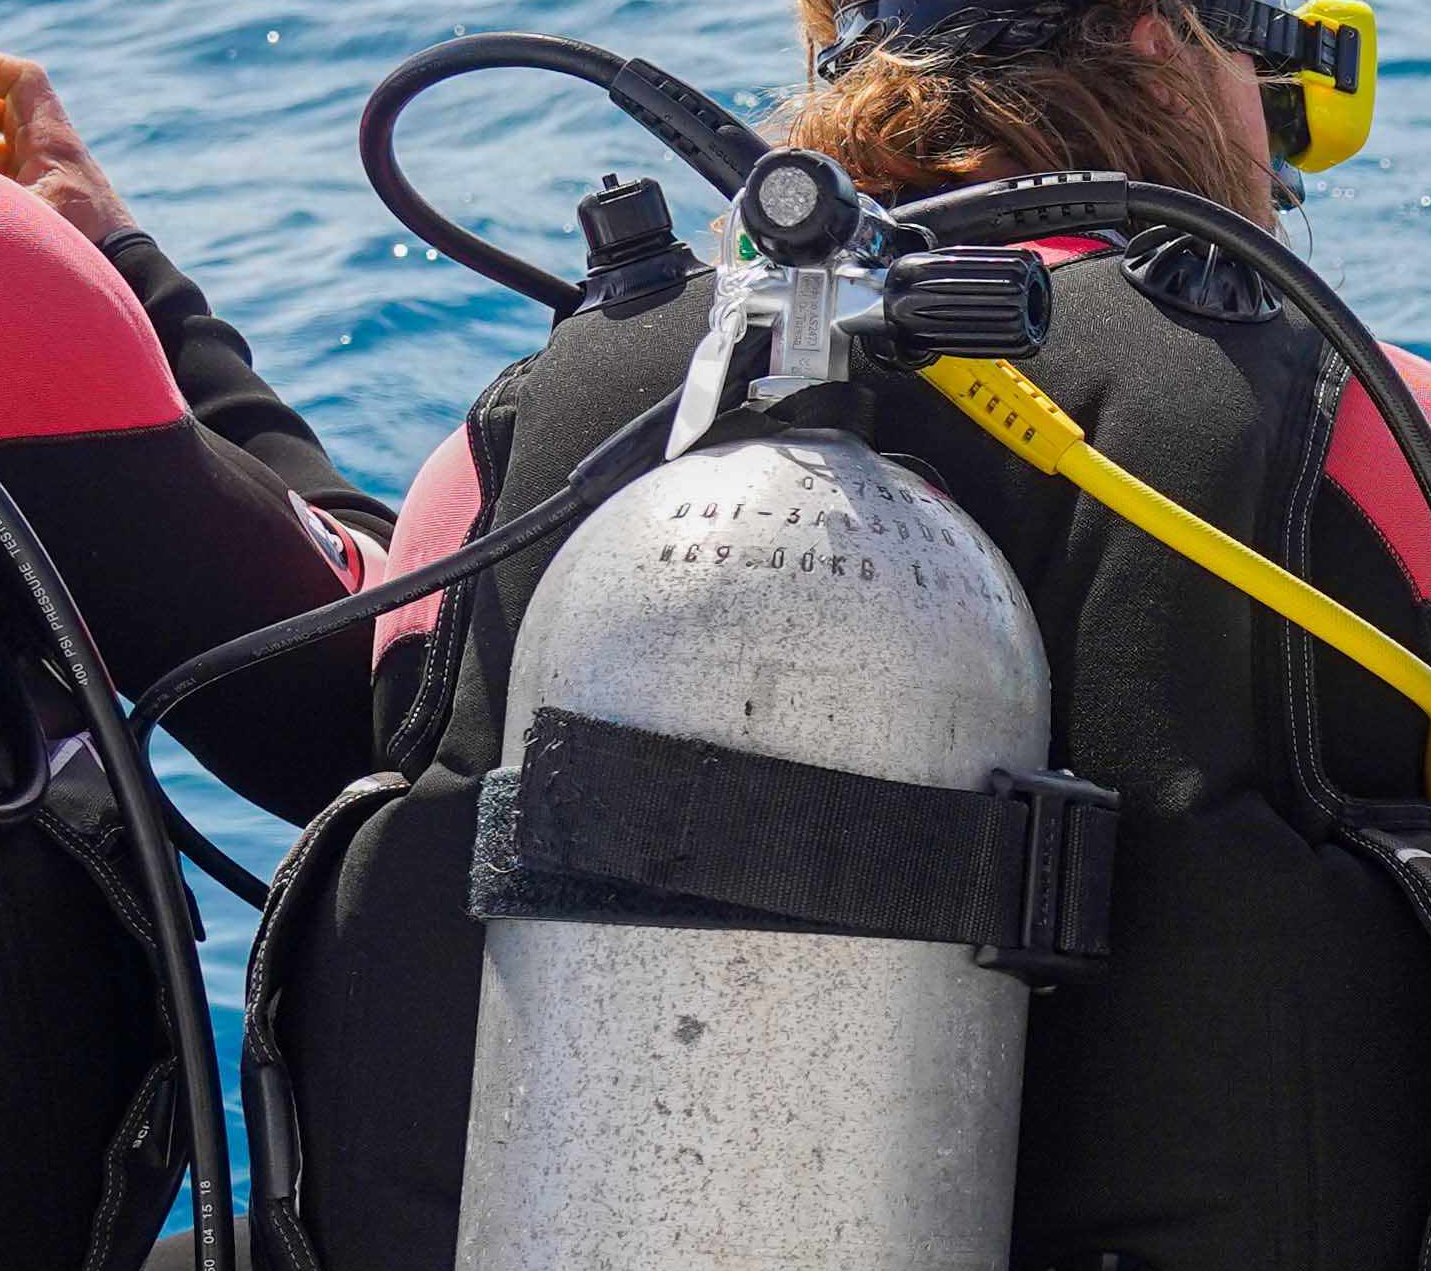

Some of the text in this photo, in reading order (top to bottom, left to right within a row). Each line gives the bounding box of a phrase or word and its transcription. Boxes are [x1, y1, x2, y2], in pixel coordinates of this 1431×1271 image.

[19, 562, 64, 631] PRESSURE
[58, 635, 78, 659] PSI
[71, 663, 90, 687] 400
[200, 1180, 211, 1196] 18
[202, 1204, 214, 1222] 15
[204, 1228, 216, 1244] 04
